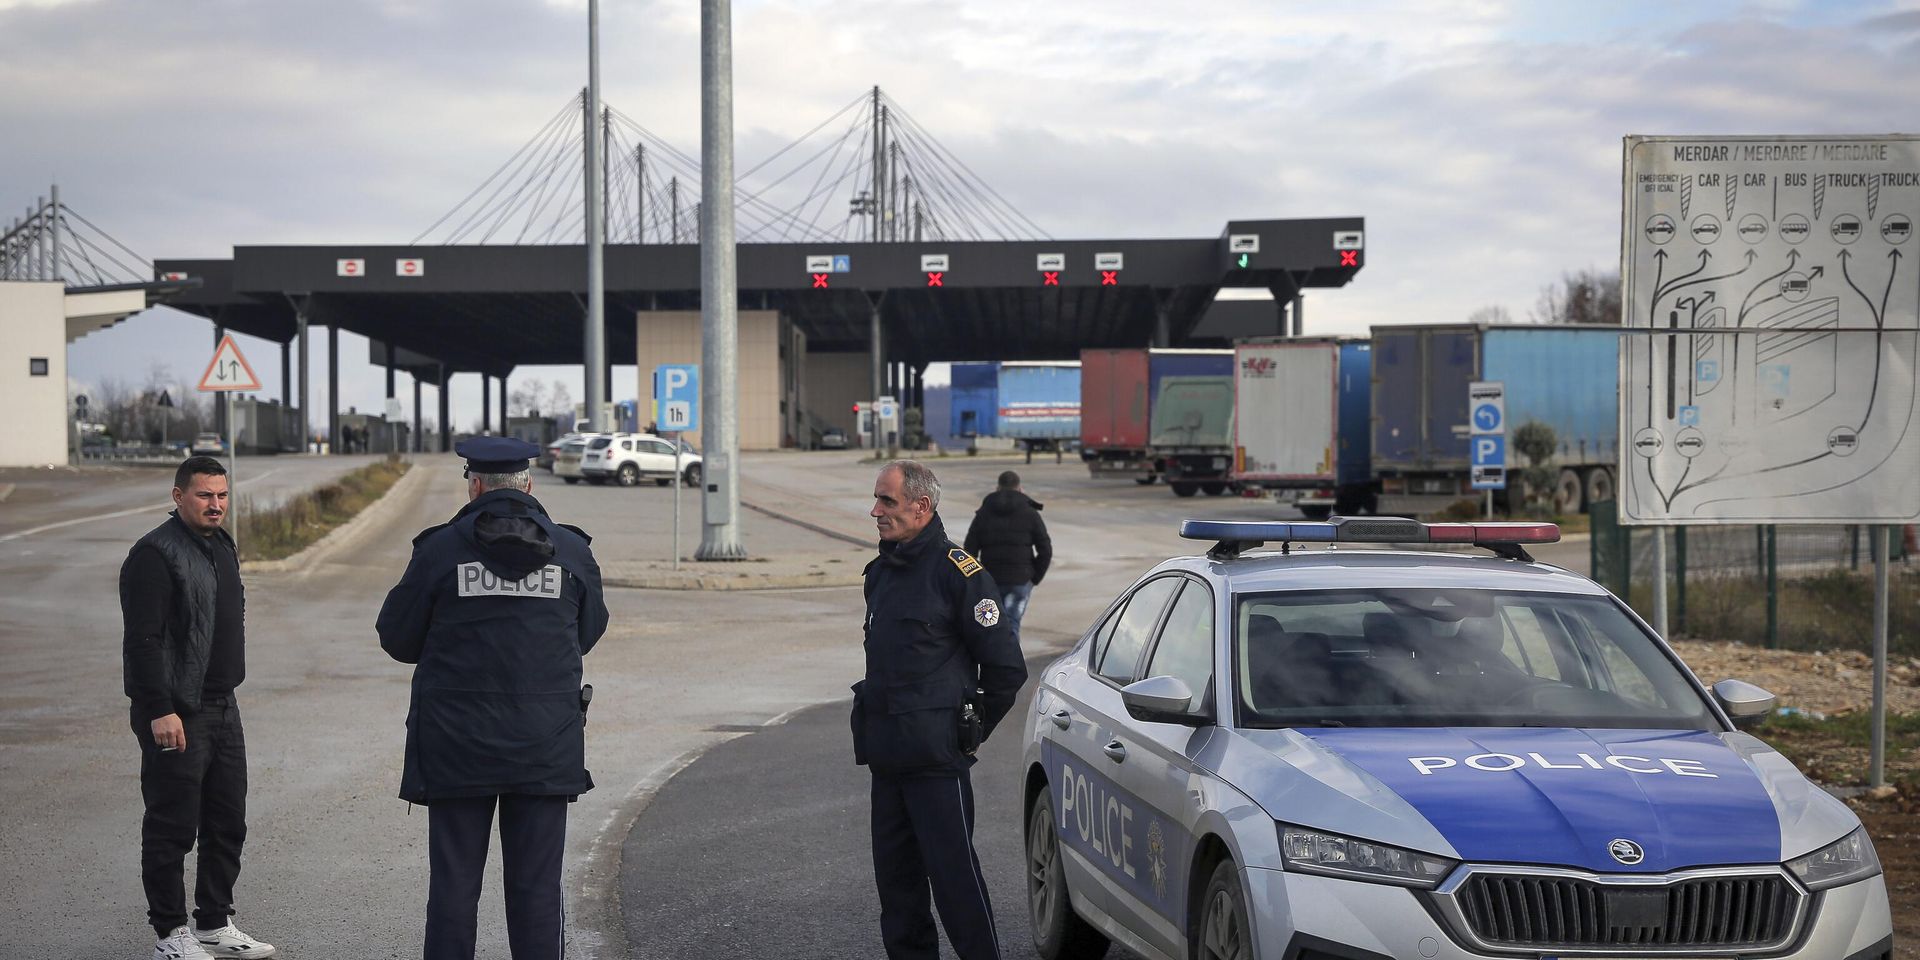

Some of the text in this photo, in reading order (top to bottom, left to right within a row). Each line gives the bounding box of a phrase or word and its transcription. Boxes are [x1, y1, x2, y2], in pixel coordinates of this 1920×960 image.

[1674, 145, 1729, 161] MERDAR
[1744, 145, 1808, 161] MERDARE
[1823, 145, 1888, 160] MERDARE
[1698, 173, 1720, 187] CAR
[1744, 173, 1766, 187] CAR
[1785, 173, 1807, 187] BUS
[1828, 173, 1866, 187] TRUCK
[1882, 172, 1920, 187] TRUCK
[1702, 363, 1714, 379] P
[665, 368, 688, 399] P
[669, 408, 683, 422] 1h
[1684, 408, 1695, 422] P
[1477, 440, 1497, 464] P
[1407, 752, 1719, 779] POLICE
[1061, 764, 1136, 879] POLICE
